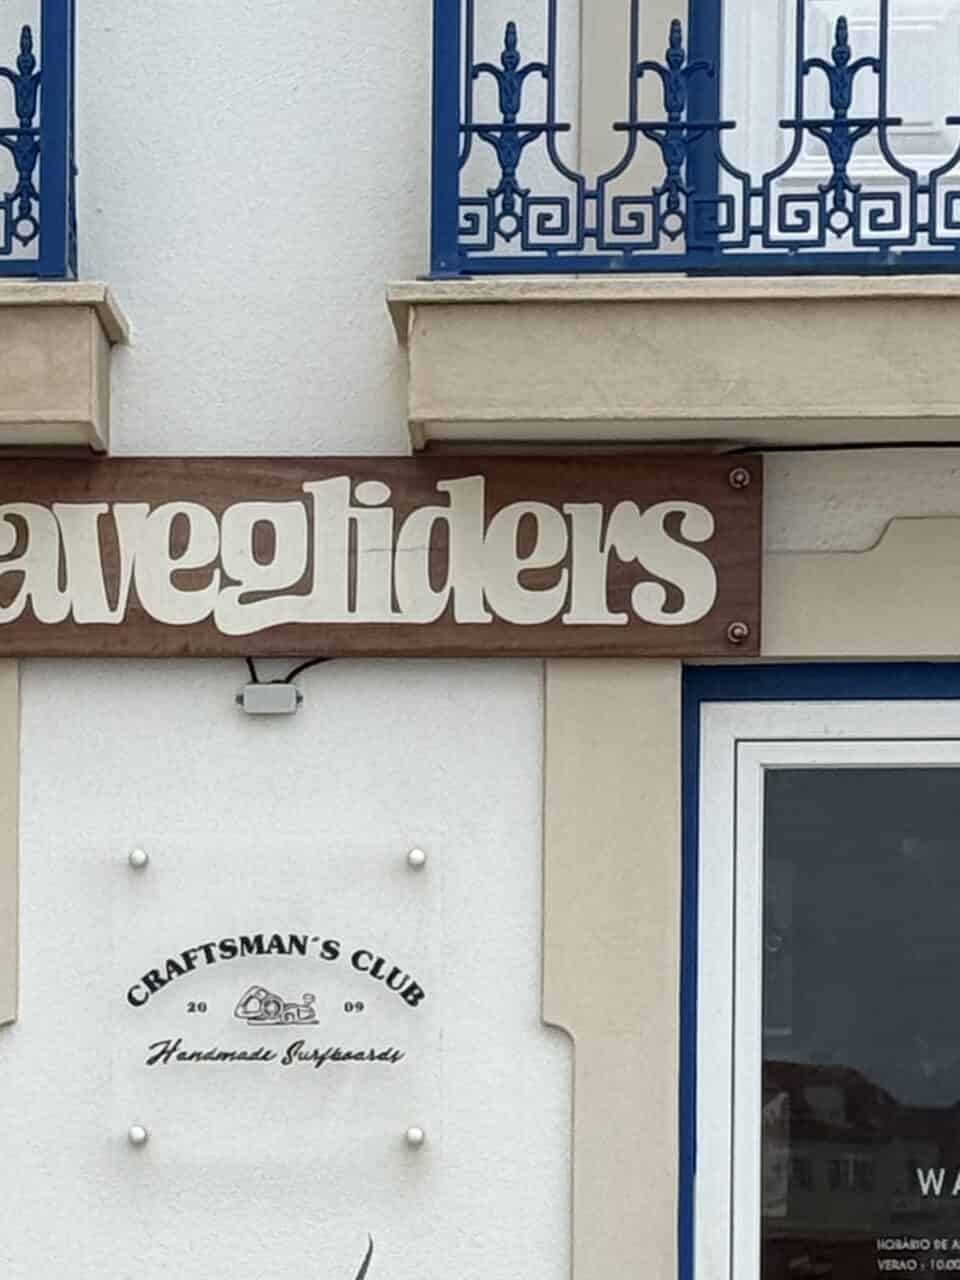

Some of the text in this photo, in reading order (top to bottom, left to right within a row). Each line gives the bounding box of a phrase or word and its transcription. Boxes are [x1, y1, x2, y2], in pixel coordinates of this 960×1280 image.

[350, 949, 426, 1008] CLUB
[187, 1000, 208, 1014] 20
[343, 1001, 365, 1014] 09
[145, 1038, 406, 1069] Handmade Surfboards
